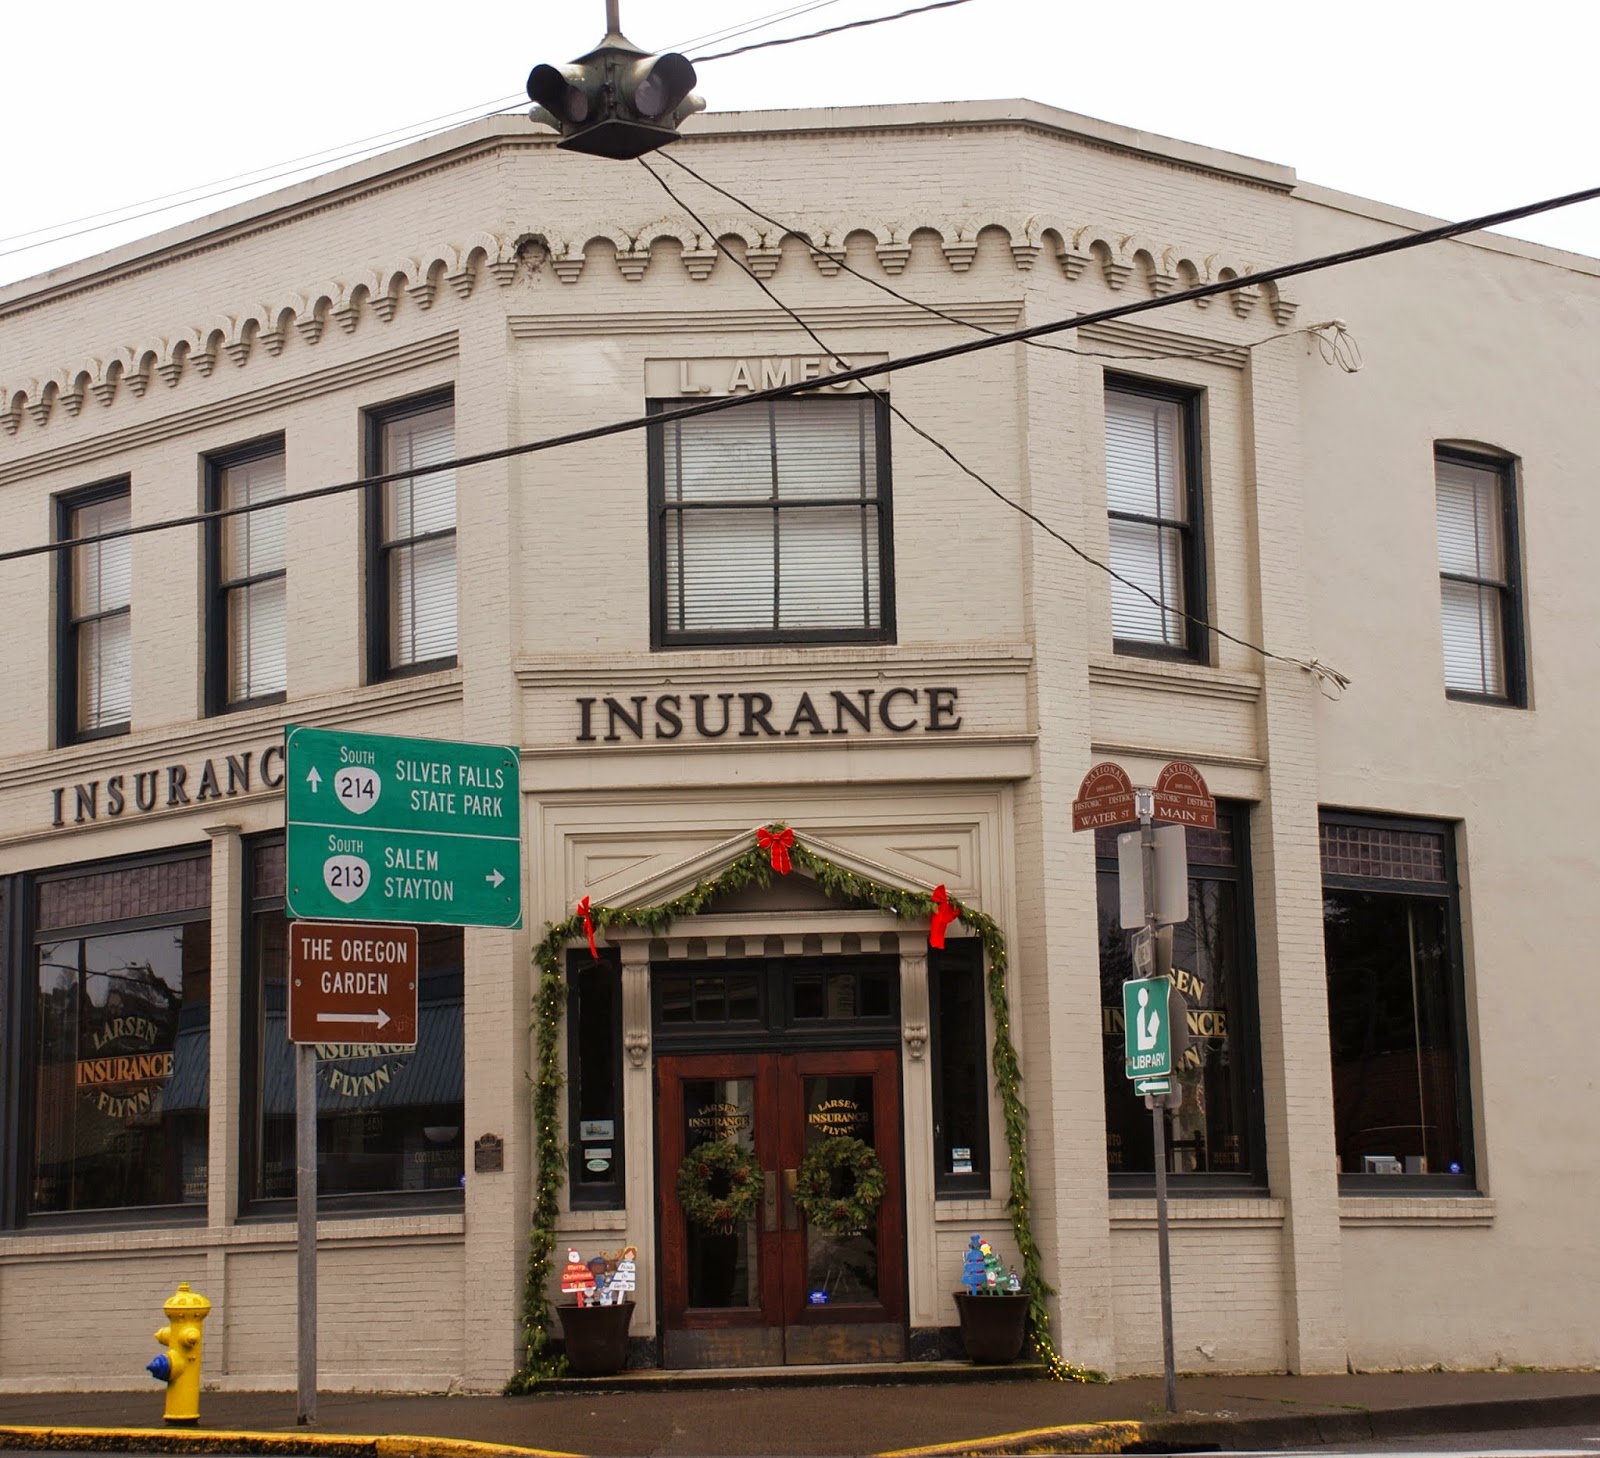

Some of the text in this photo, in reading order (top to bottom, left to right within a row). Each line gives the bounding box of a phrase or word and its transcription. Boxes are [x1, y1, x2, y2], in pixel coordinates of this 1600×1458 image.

[680, 356, 852, 394] L. AMES
[576, 687, 962, 741] INSURANCE
[51, 745, 285, 826] INSURANC
[396, 760, 504, 789] SILVER FALLS
[1084, 765, 1125, 787] NATIONAL
[1163, 765, 1202, 784] NATIONAL
[341, 777, 375, 799] 214
[411, 790, 503, 817] STATE PARK
[1074, 793, 1136, 811] HISTORIC DISTRICT
[1186, 797, 1214, 808] DISTRICT
[1081, 810, 1130, 826] WATER ST
[1160, 807, 1209, 822] MAIN ST
[385, 847, 438, 871] SALEM
[331, 866, 364, 888] 213
[384, 877, 454, 901] STAYTON
[301, 938, 407, 963] THE OREGON
[321, 971, 388, 995] GARDEN
[1170, 967, 1205, 1000] SEN
[92, 1016, 159, 1050] LARSEN
[77, 1054, 174, 1084] INSURANCE
[1132, 1052, 1166, 1070] LIBRARY
[330, 1064, 390, 1097] FLYNN
[98, 1088, 151, 1118] FLYNN
[817, 1099, 859, 1111] LARSEN
[688, 1116, 749, 1128] INSURANCE
[808, 1112, 868, 1123] INSURANCE
[822, 1125, 855, 1135] FLYNN
